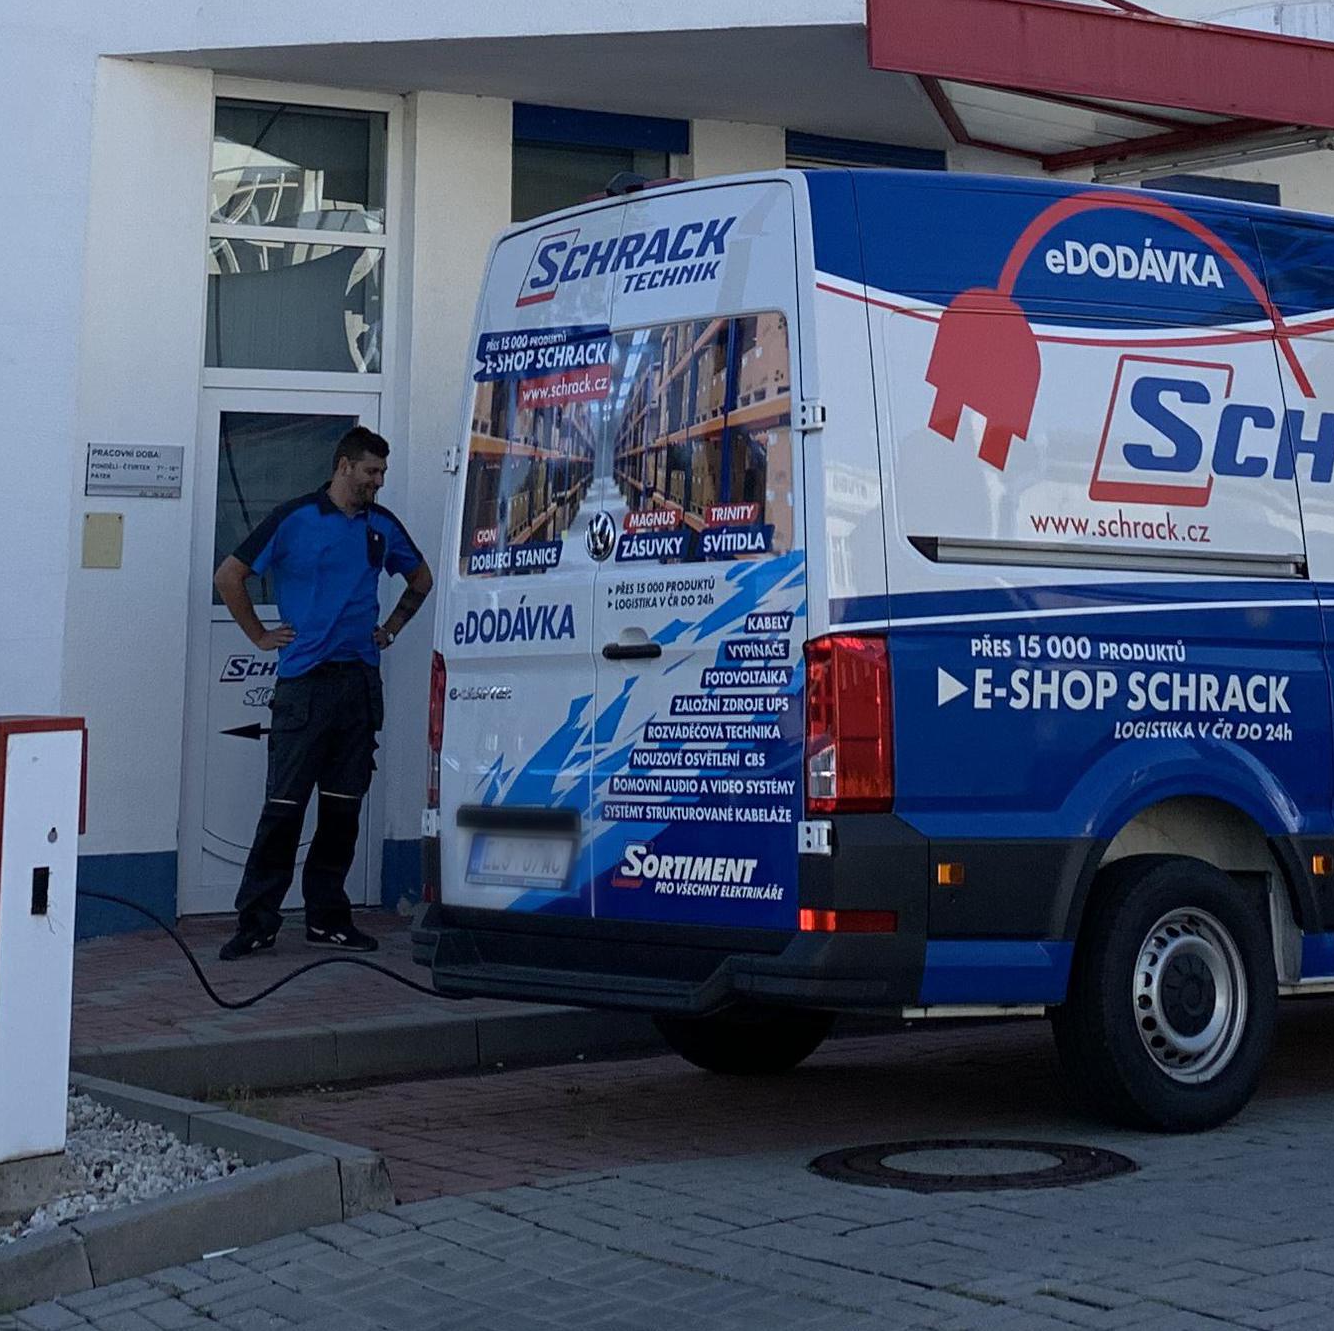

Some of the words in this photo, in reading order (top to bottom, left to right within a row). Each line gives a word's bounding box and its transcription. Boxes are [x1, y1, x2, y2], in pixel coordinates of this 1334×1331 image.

[529, 216, 737, 289] SCHRACK
[1045, 238, 1225, 289] eDODÁVKA
[623, 261, 722, 294] TECHNIK
[501, 336, 510, 350] 15
[510, 334, 528, 349] 000
[485, 348, 534, 374] E-SHOP
[535, 342, 608, 369] SCHRACK
[522, 373, 608, 402] www.schrack.cz
[629, 510, 676, 528] MAGNUS
[711, 505, 755, 521] TRINITY
[1029, 510, 1212, 545] www.schrack.cz
[621, 535, 684, 558] ZÁSUVKY
[703, 528, 766, 553] SVÍTIDLA
[471, 547, 512, 570] DOBÍJECÍ
[515, 547, 557, 567] STANICE
[616, 581, 634, 595] PŘES
[637, 582, 646, 594] 15
[647, 581, 664, 593] 000
[666, 576, 715, 592] PRODUKTŮ
[615, 596, 657, 610] LOGISTIKA
[659, 596, 666, 607] V
[667, 594, 678, 606] ČR
[681, 595, 695, 606] DO
[697, 593, 714, 605] 24h
[453, 595, 575, 645] eDODÁVKA
[747, 615, 791, 631] KABELY
[728, 642, 786, 658] VYPÍNAČE
[970, 634, 1012, 658] PŘES
[1017, 635, 1041, 659] 15
[1046, 636, 1091, 660] 000
[1098, 639, 1186, 662] PRODUKTŮ
[705, 670, 788, 686] FOTOVOLTAIKA
[973, 668, 1118, 710] E-SHOP
[1127, 671, 1292, 714] SCHRACK
[675, 696, 720, 712] ZÁLOŽNÍ
[722, 698, 765, 713] ZDROJE
[767, 697, 789, 711] UPS
[647, 722, 723, 740] ROZVÁDĚČOVÁ
[725, 725, 781, 740] TECHNIKA
[1114, 721, 1195, 740] LOGISTIKA
[1197, 722, 1210, 739] V
[1212, 718, 1232, 740] ČR
[1236, 723, 1262, 740] DO
[1265, 723, 1293, 741] 24h
[633, 750, 683, 766] NOUZOVÉ
[684, 750, 740, 767] OSVĚTLENÍ
[744, 753, 766, 767] CBS
[613, 776, 662, 791] DOMOVNÍ
[664, 778, 698, 792] AUDIO
[700, 780, 708, 793] A
[710, 780, 744, 794] VIDEO
[745, 778, 796, 796] SYSTÉMY
[604, 803, 644, 819] SYSTÉMY
[645, 805, 733, 821] STRUKTUROVANÉ
[735, 806, 792, 823] KABELÁŽE
[620, 844, 759, 883] SORTIMENT
[654, 881, 674, 894] PRO
[676, 880, 720, 897] VŠECHNY
[720, 884, 785, 901] ELEKTRIKÁŘE
